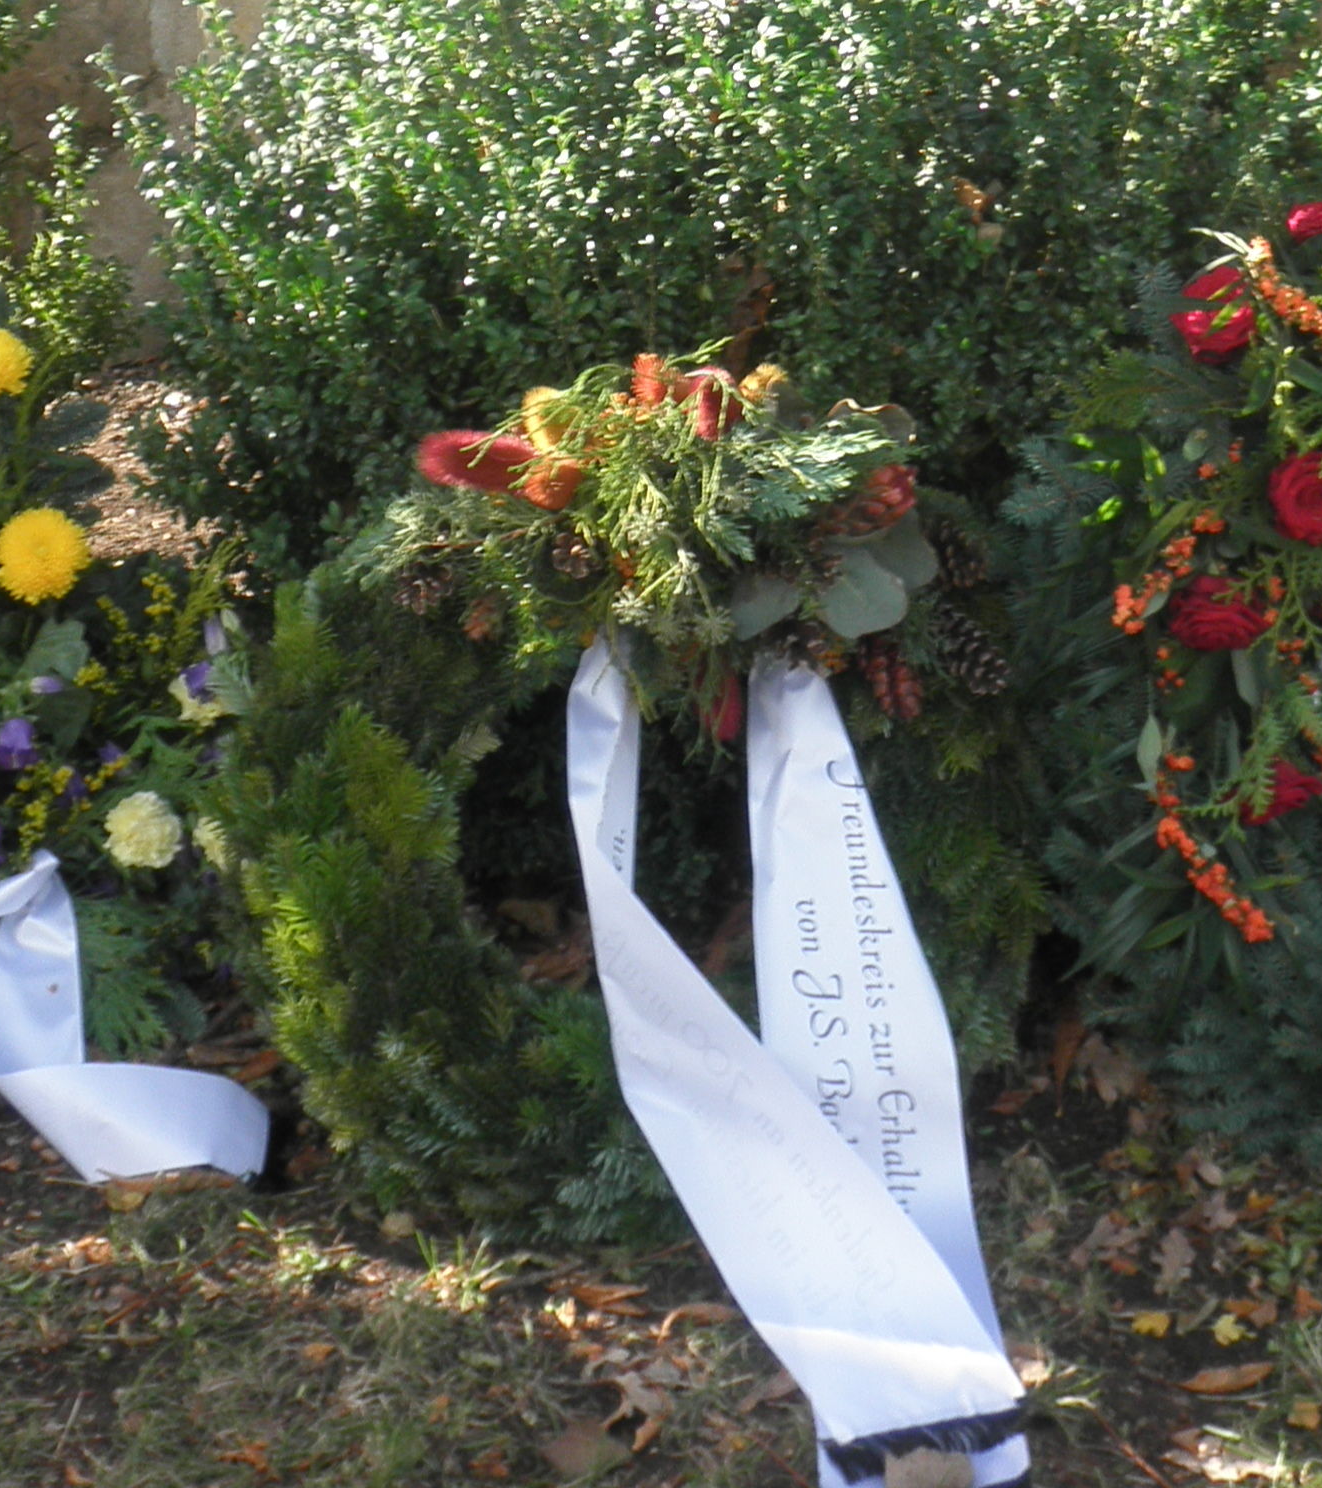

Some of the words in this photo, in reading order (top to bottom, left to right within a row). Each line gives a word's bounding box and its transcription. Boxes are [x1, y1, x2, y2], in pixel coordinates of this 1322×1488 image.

[794, 897, 821, 954] von
[816, 1058, 859, 1144] Ba
[869, 1023, 894, 1076] zur
[877, 1089, 921, 1214] Erhalt
